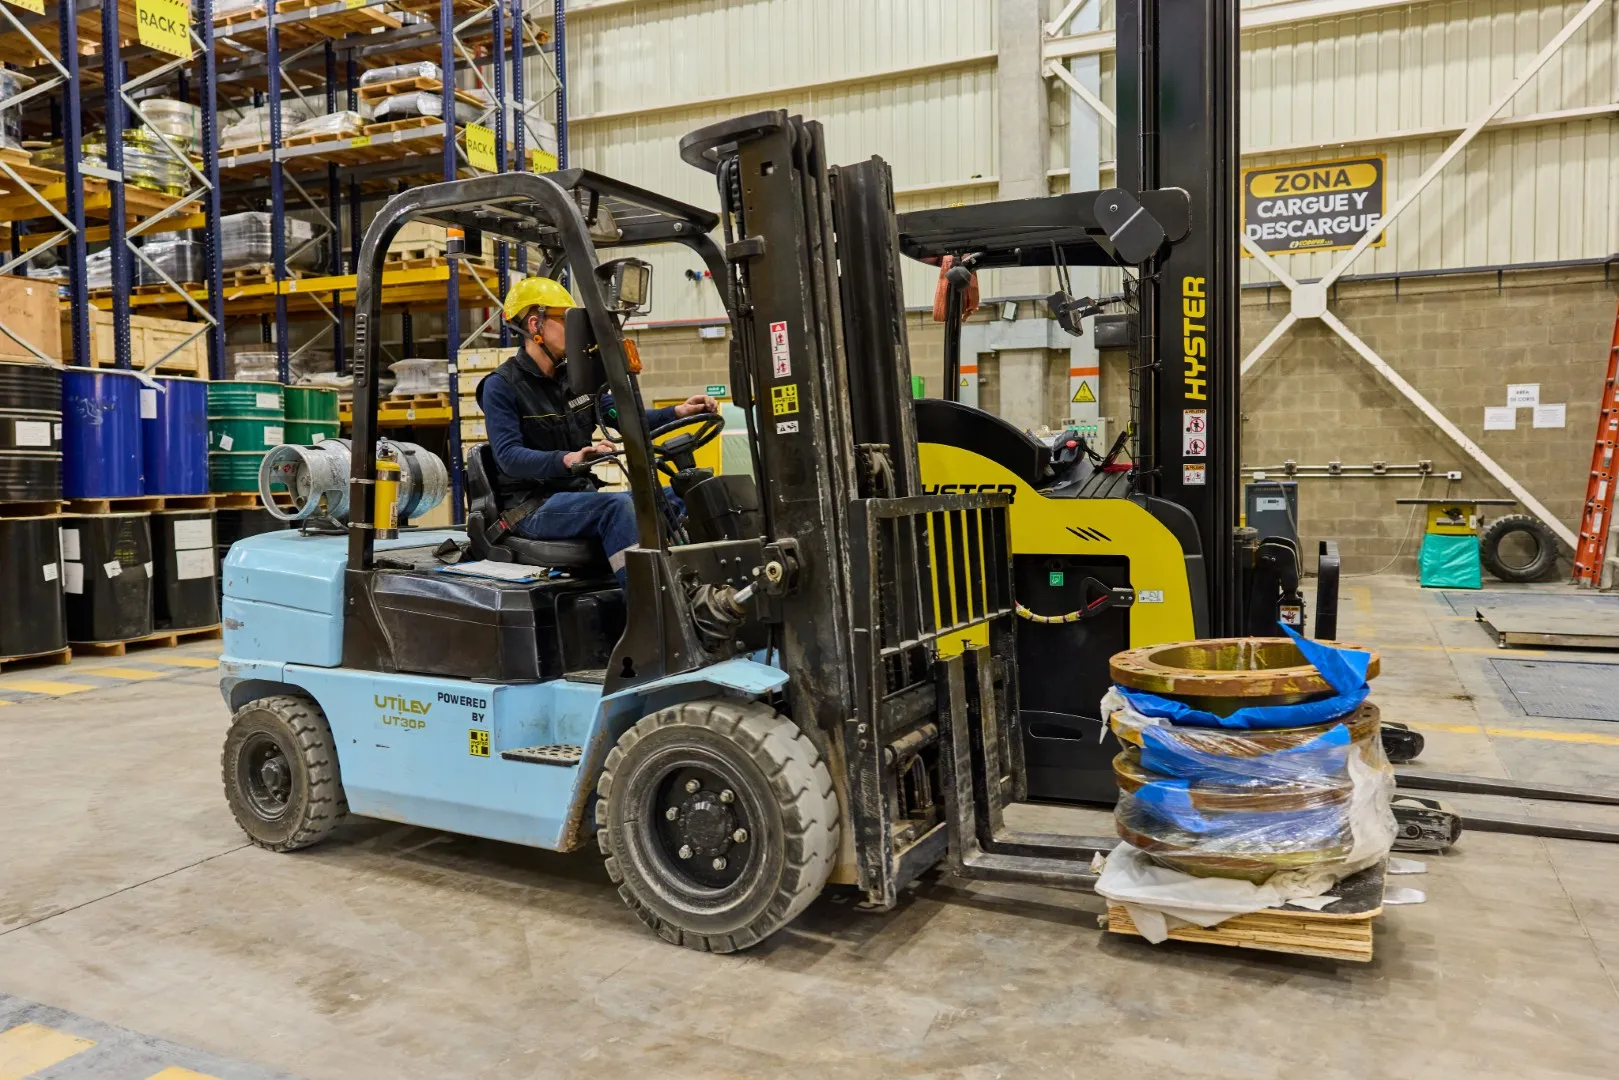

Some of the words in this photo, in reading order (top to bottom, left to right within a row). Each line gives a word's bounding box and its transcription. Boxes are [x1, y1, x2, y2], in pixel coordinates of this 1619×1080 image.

[140, 9, 176, 35] RACK
[179, 23, 187, 38] 3
[467, 139, 488, 155] RACK
[489, 146, 494, 156] 4
[1274, 169, 1352, 193] ZONA
[1257, 193, 1349, 218] CARGUE
[1352, 192, 1368, 209] Y
[1246, 213, 1381, 240] DESCARGUE
[1183, 276, 1207, 400] HYSTER
[374, 694, 432, 715] UTILEV
[437, 692, 487, 709] POWERED
[383, 715, 426, 729] UT30P
[471, 712, 485, 723] BY
